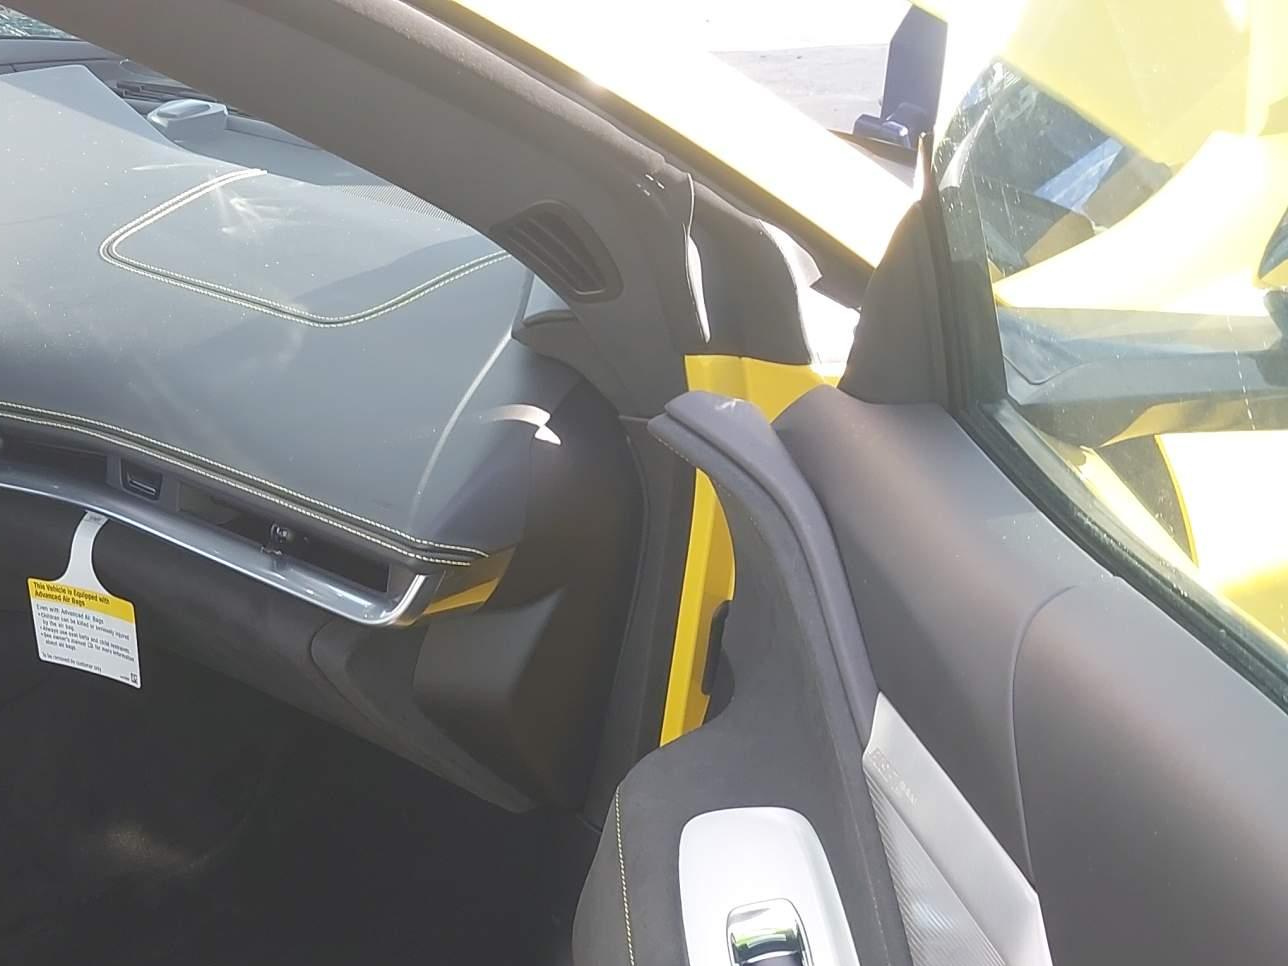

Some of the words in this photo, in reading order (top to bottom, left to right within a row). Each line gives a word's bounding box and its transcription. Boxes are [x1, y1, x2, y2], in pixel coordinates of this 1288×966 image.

[33, 582, 44, 590] This
[45, 583, 66, 594] Vehicle
[73, 589, 98, 602] Equipped
[99, 596, 110, 604] with
[35, 590, 62, 601] Advanced
[62, 595, 71, 603] Air
[72, 597, 86, 607] Bags
[37, 604, 48, 612] Even
[61, 608, 84, 619] Advanced
[92, 615, 104, 625] Bags
